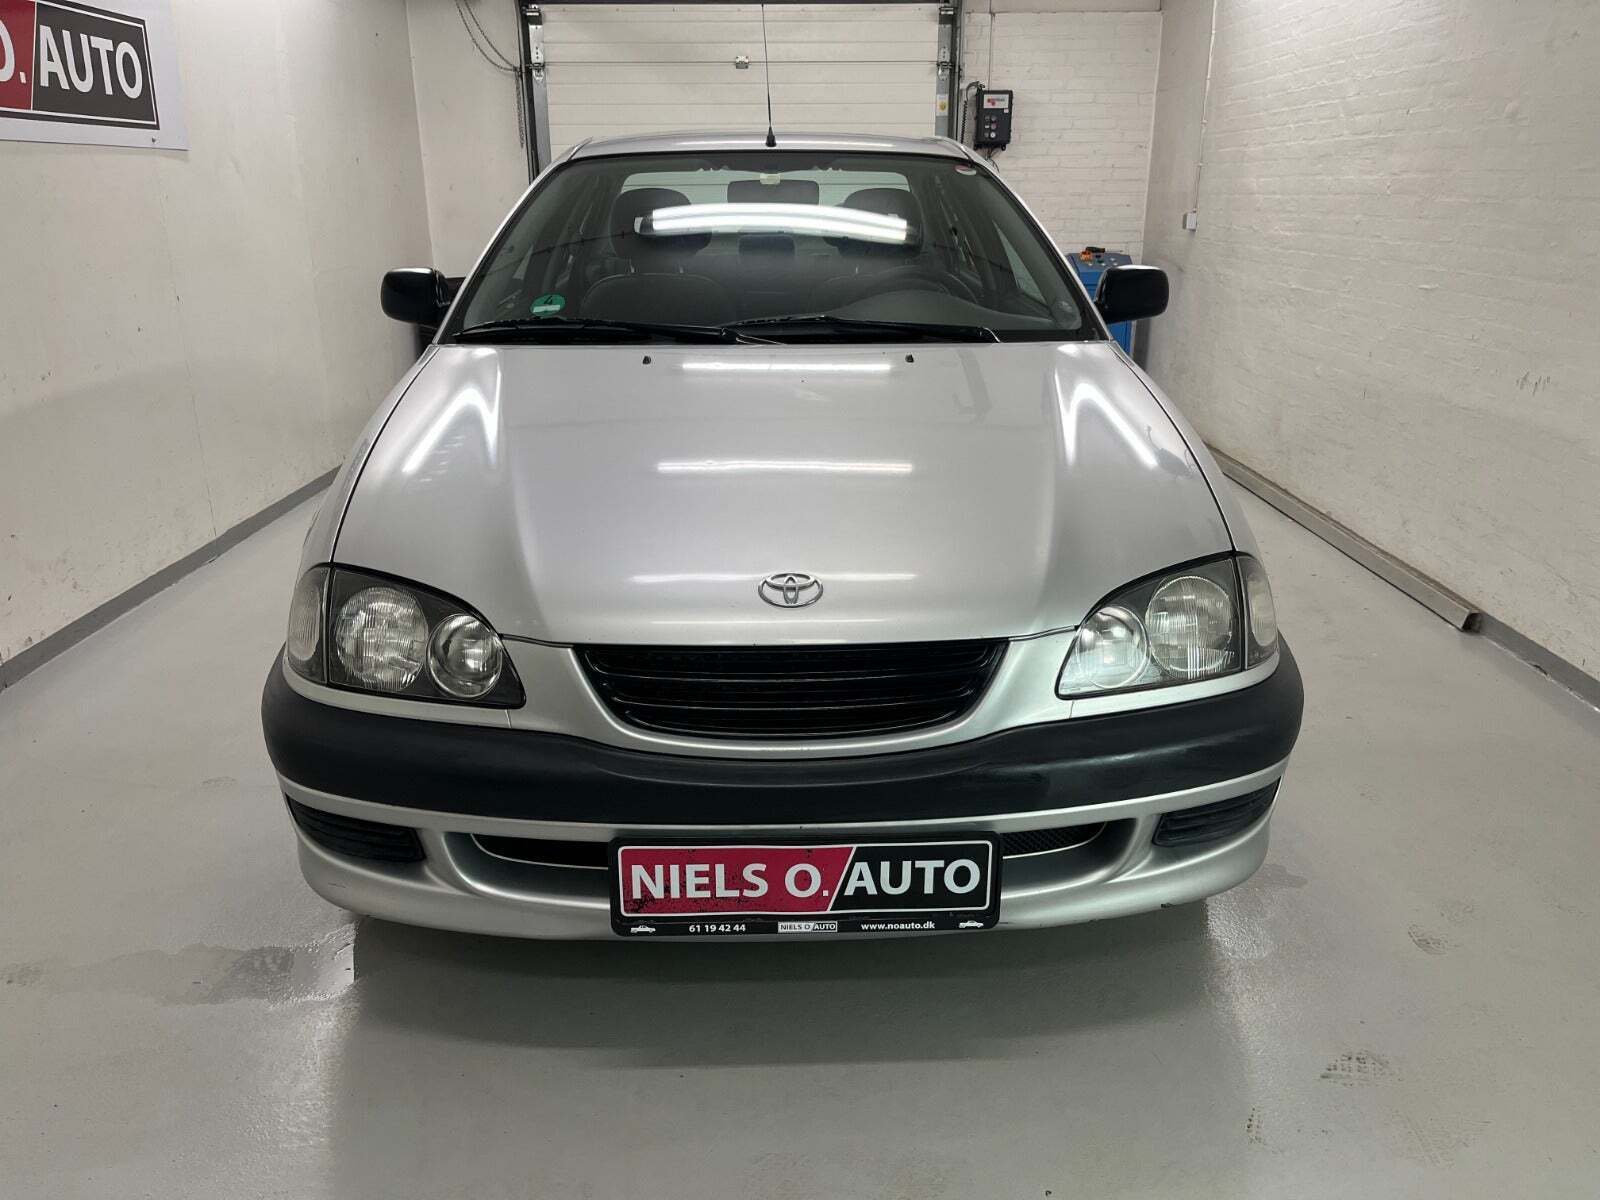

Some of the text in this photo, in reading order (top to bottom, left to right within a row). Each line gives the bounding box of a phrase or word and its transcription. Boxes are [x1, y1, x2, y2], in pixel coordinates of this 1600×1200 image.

[39, 24, 143, 99] AUTO
[631, 859, 981, 899] NIELS O. AUTO
[689, 923, 746, 933] 61 19 42 44
[814, 923, 836, 931] AUTO
[861, 921, 935, 930] www.noauto.dk
